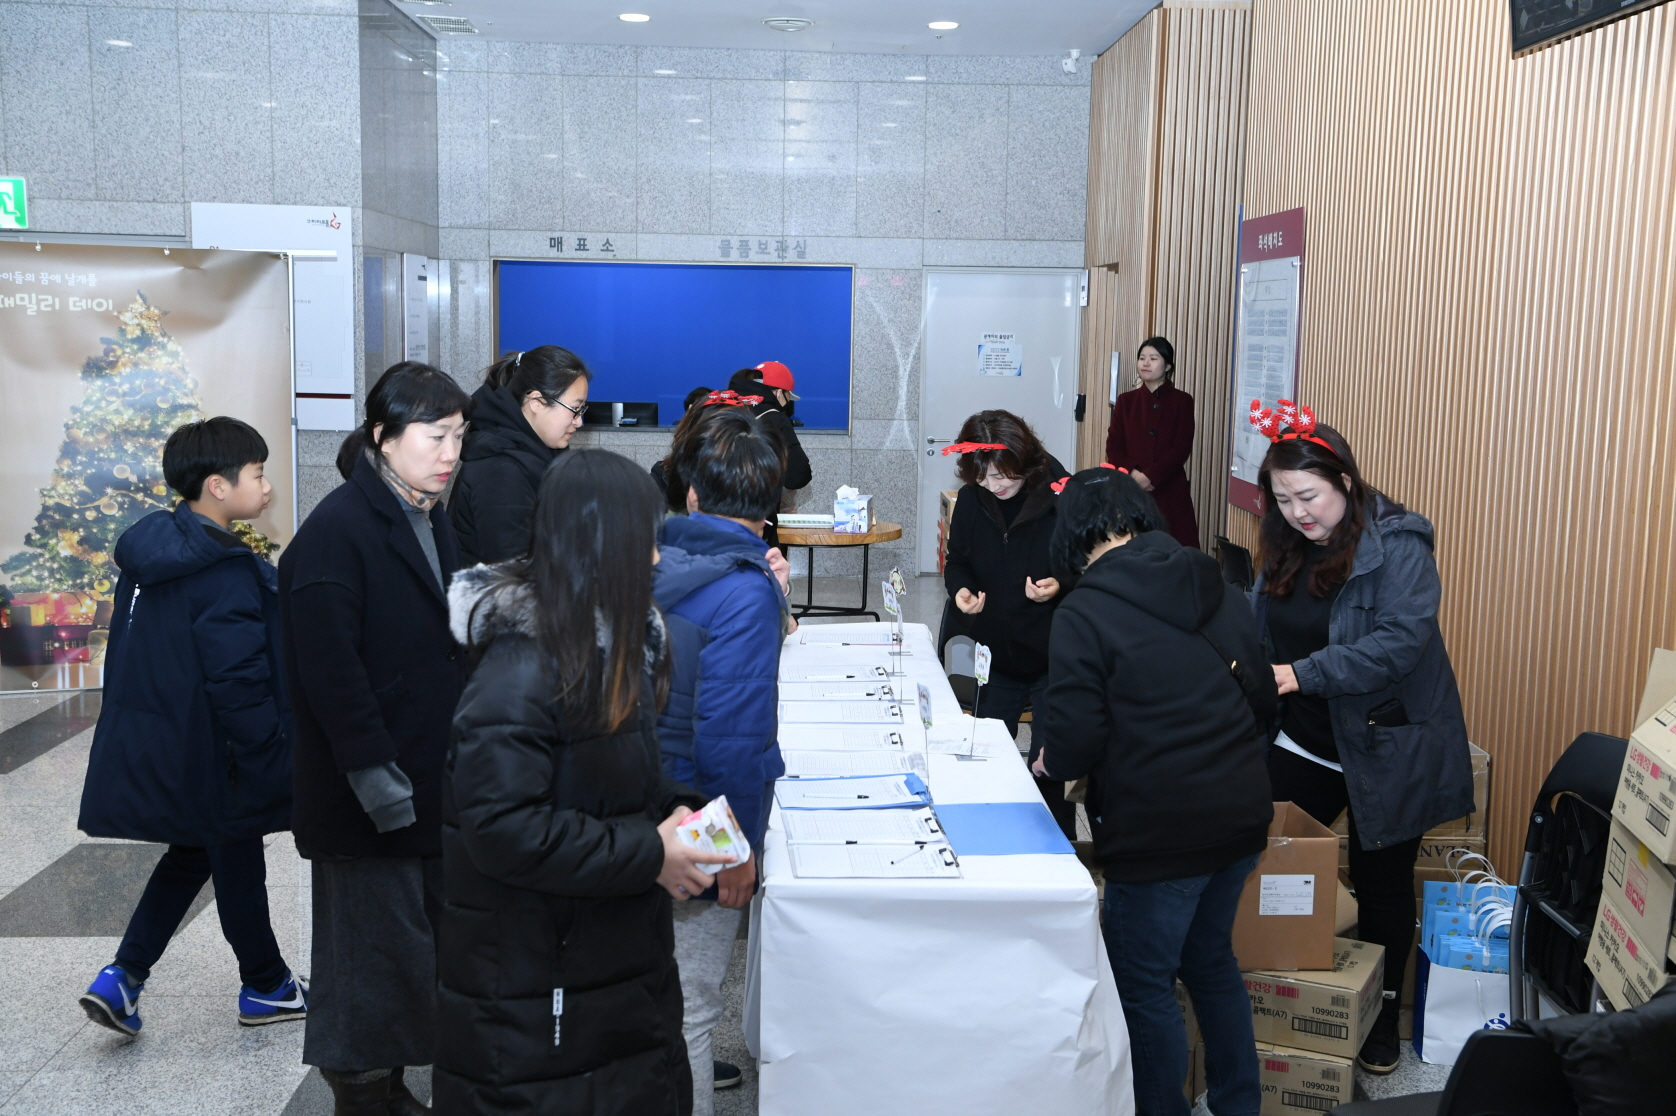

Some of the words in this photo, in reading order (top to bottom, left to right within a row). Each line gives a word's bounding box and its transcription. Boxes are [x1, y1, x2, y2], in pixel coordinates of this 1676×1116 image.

[717, 238, 807, 259] 물품보관실
[39, 272, 61, 285] 꿈에
[65, 273, 97, 287] 날개를
[68, 297, 113, 312] 데이
[1249, 994, 1264, 1005] 카오
[1311, 1006, 1349, 1020] 10990283
[1301, 1080, 1340, 1093] 10990283
